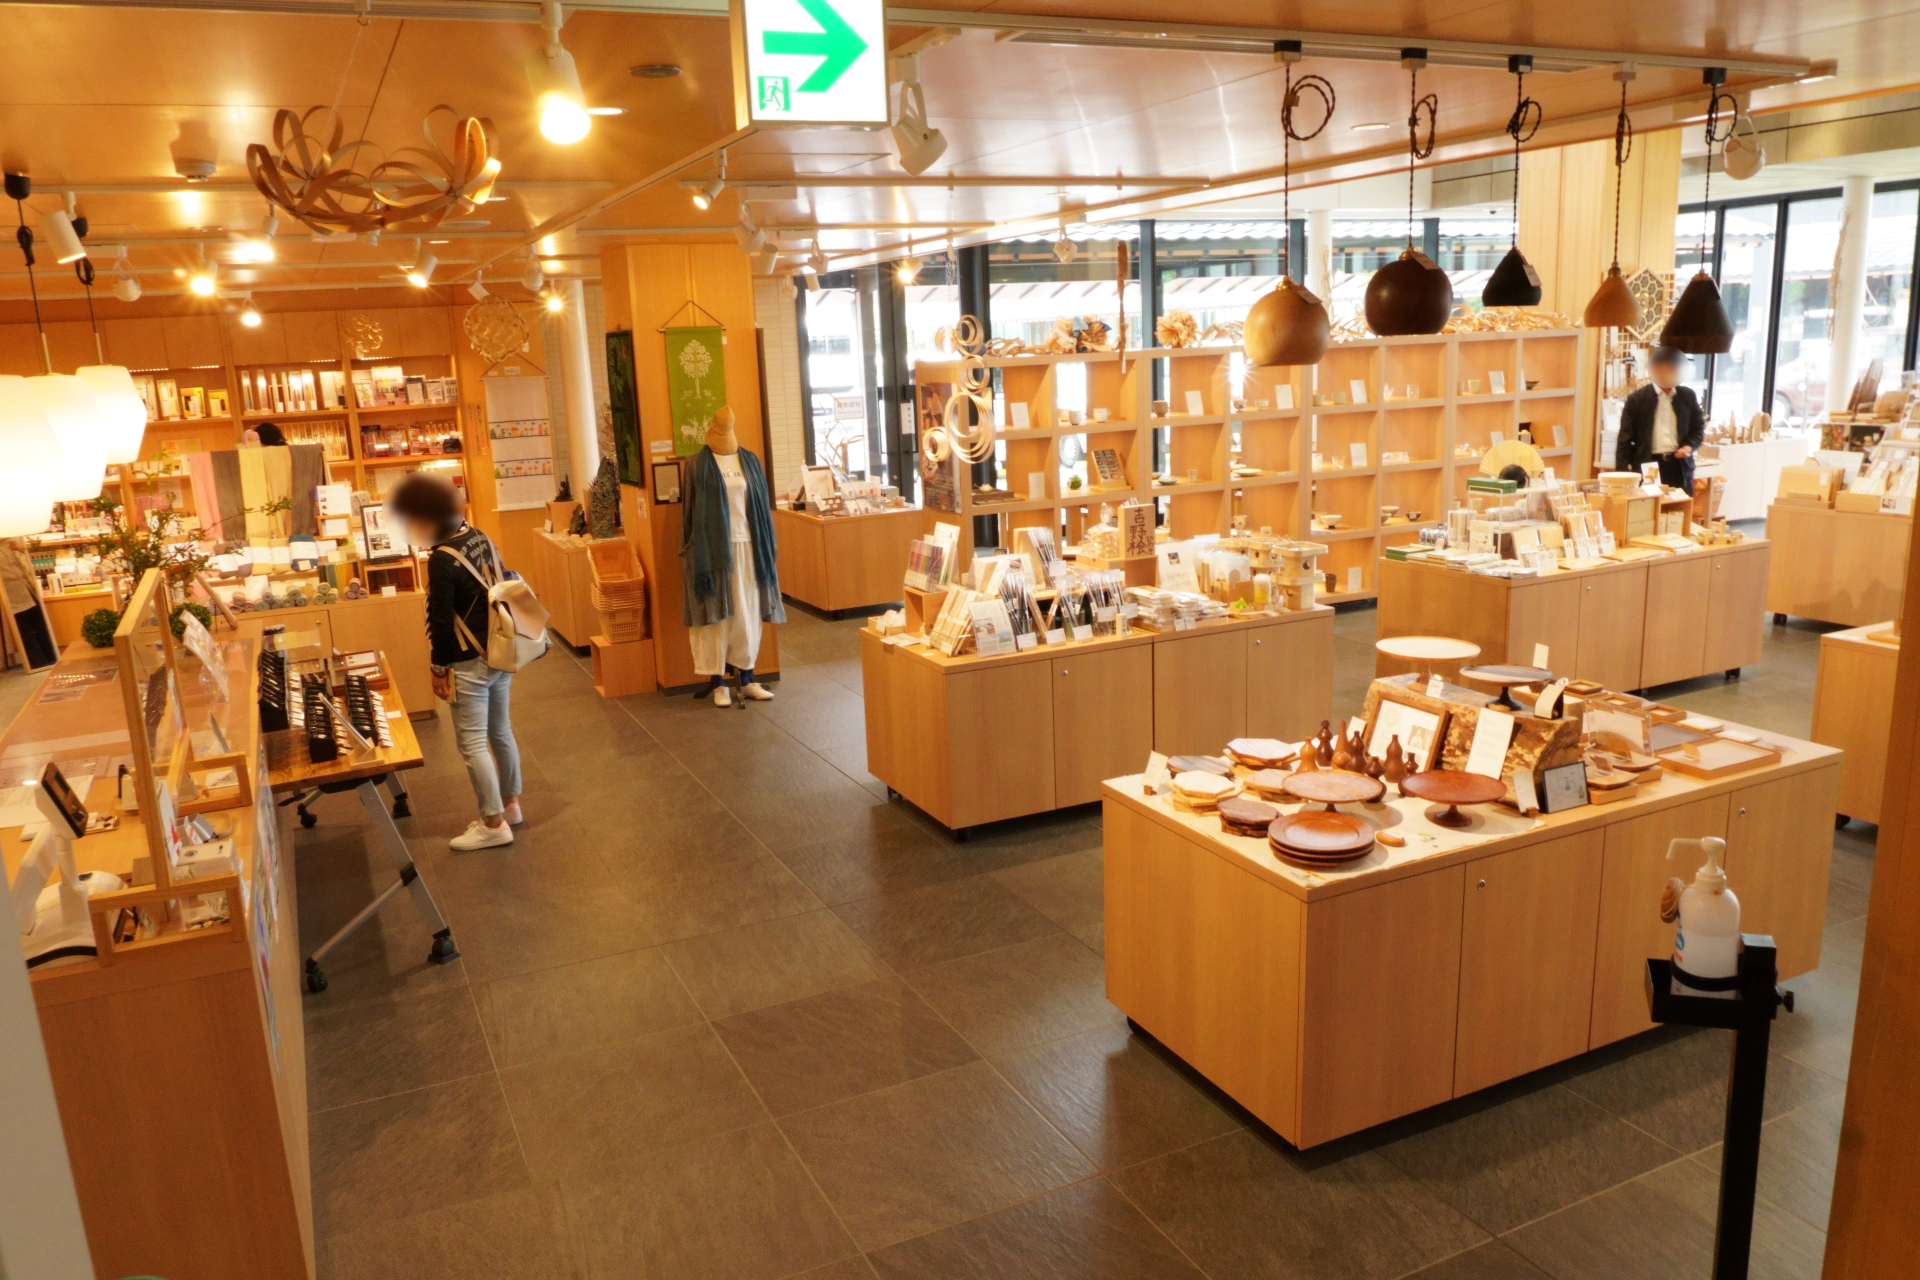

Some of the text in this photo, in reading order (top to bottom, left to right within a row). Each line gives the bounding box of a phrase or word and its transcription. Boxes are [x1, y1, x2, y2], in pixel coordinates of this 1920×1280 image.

[1127, 507, 1148, 556] 吉野桧
[469, 543, 488, 559] HAPPY
